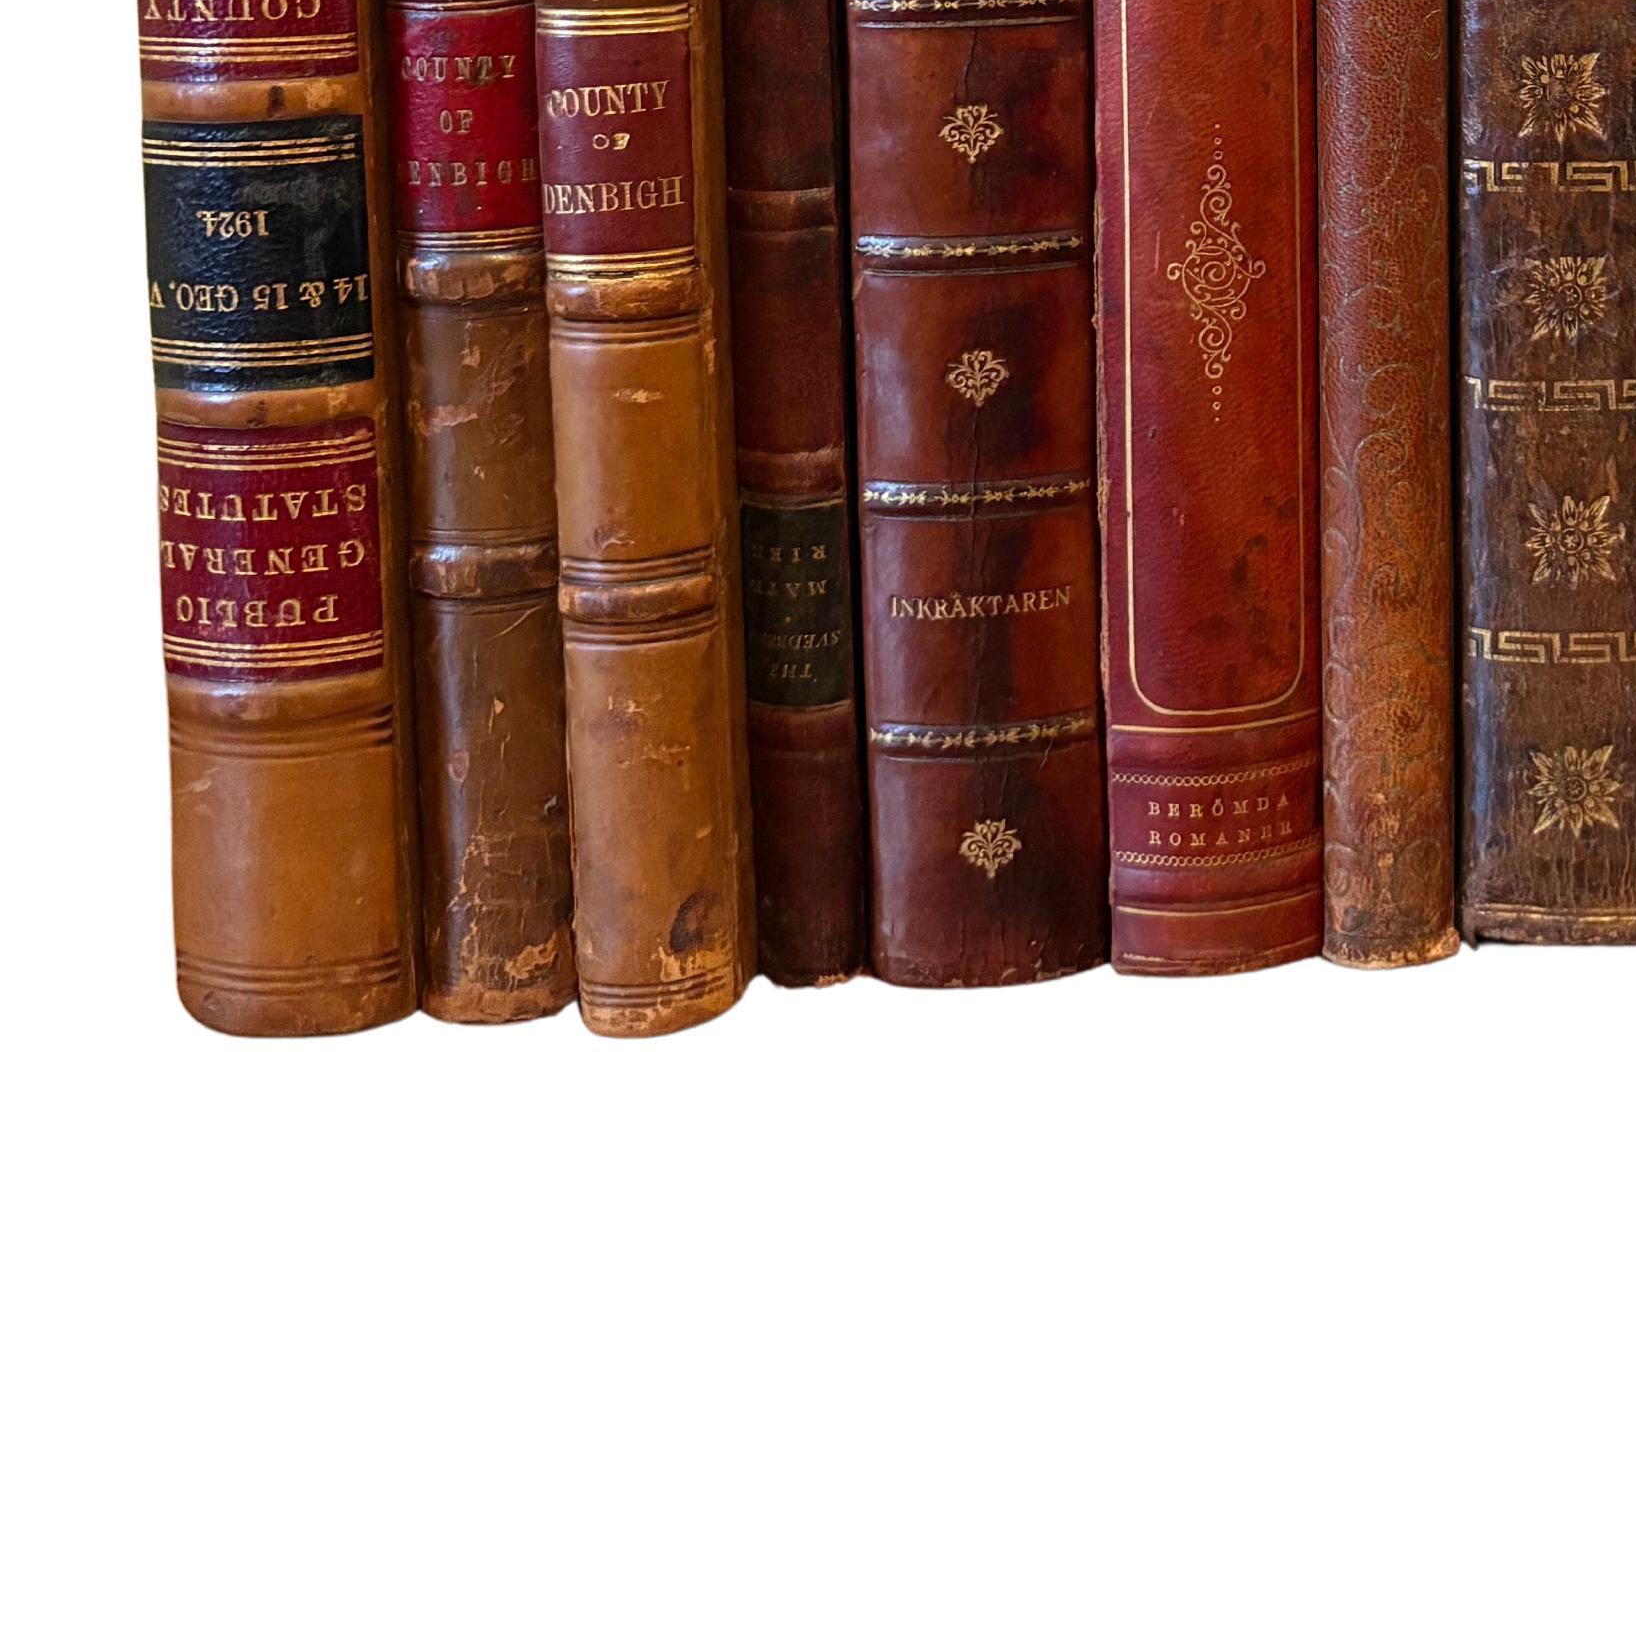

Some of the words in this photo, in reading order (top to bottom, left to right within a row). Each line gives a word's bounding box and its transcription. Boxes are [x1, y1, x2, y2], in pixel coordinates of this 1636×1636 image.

[401, 54, 516, 82] COUNTY
[546, 80, 669, 118] COUNTY
[439, 109, 474, 135] OF
[592, 131, 631, 151] OF
[407, 158, 537, 187] ENBIGH
[543, 175, 685, 214] DENBIGH
[169, 279, 240, 313] GEO.
[253, 282, 289, 311] 15
[299, 281, 326, 308] &
[333, 273, 369, 305] 14
[159, 482, 367, 522] STATUTES
[161, 538, 366, 576] GENERAL
[176, 593, 340, 628] PUBLIC
[1148, 821, 1294, 847] ROMANER
